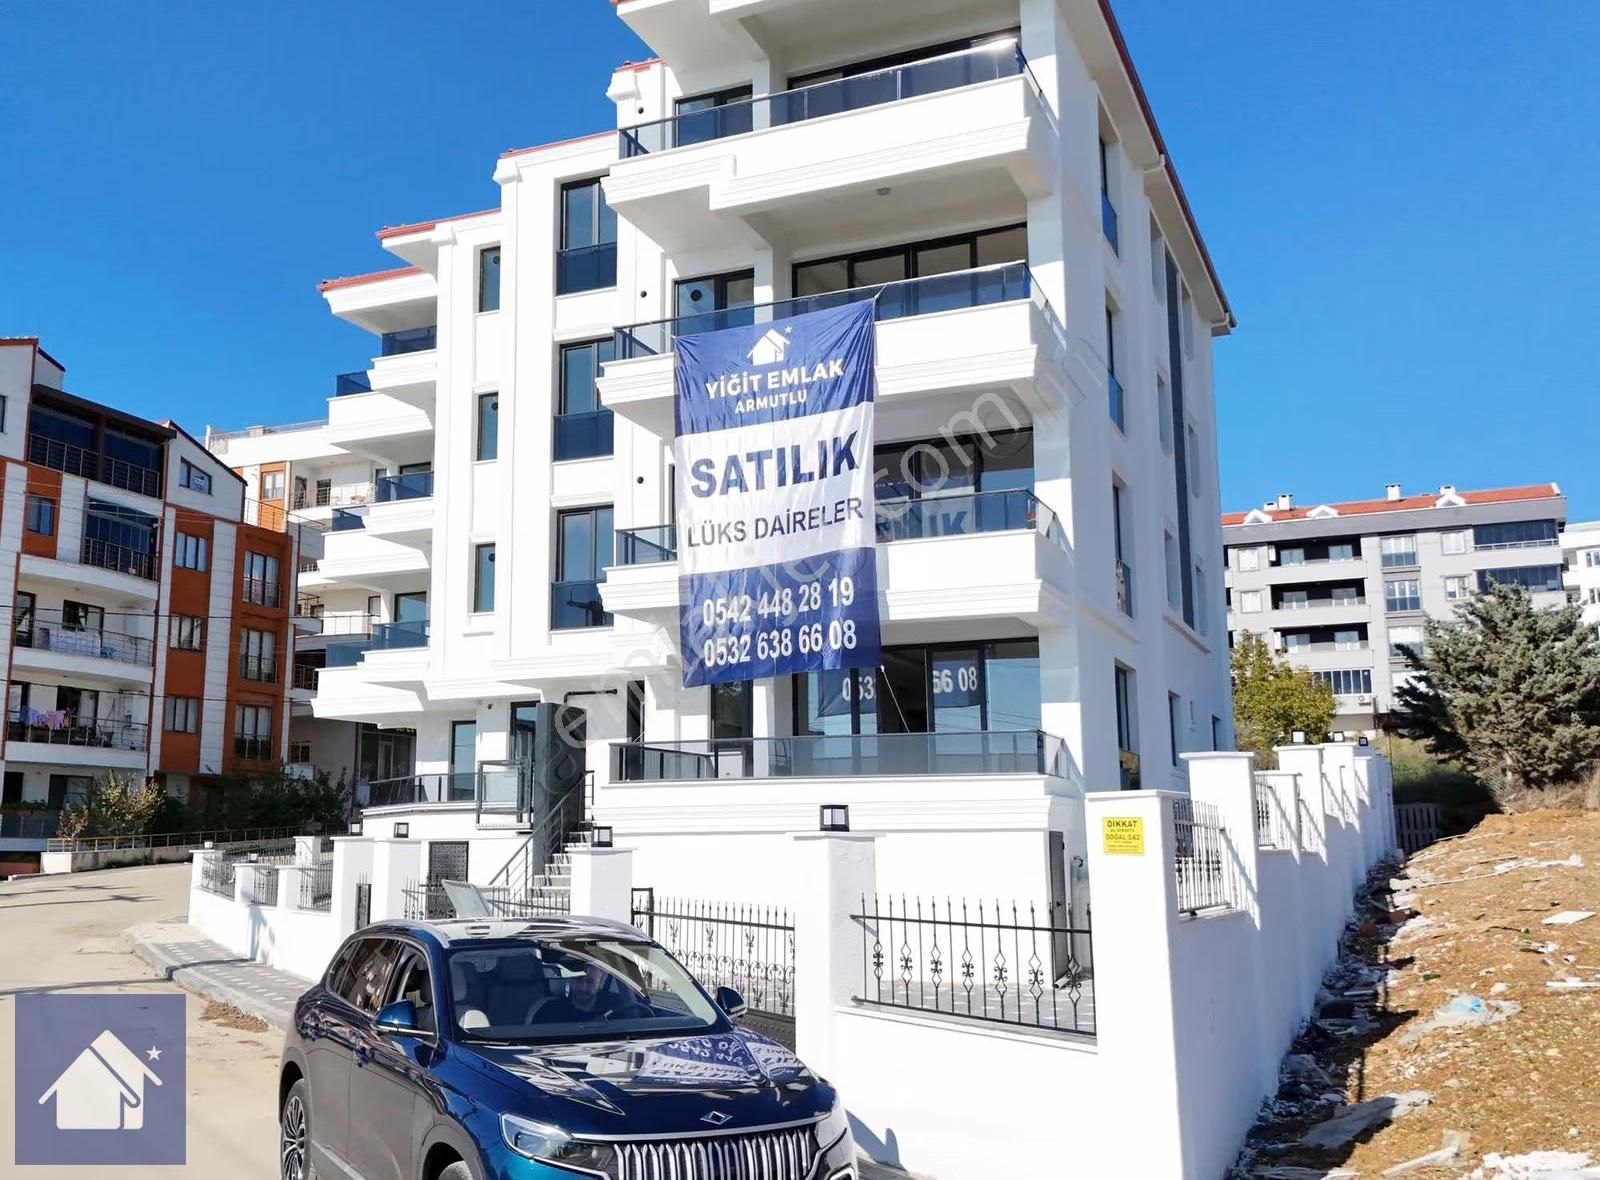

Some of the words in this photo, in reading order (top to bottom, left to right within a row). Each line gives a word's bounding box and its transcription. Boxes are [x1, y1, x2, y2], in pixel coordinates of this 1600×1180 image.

[706, 370, 762, 400] YİĞİT
[767, 357, 844, 390] EMLAK
[734, 389, 808, 415] ARMUTLU
[690, 429, 860, 499] SATILIK
[687, 519, 748, 548] LÜKS
[754, 496, 864, 540] DAİRELER
[702, 594, 751, 627] 0542
[757, 587, 793, 619] 448
[798, 581, 822, 613] 28
[828, 576, 855, 607] 19
[703, 636, 751, 668] 0532
[756, 628, 793, 661] 638
[798, 622, 823, 654] 66
[828, 619, 857, 651] 08
[957, 665, 978, 693] 08
